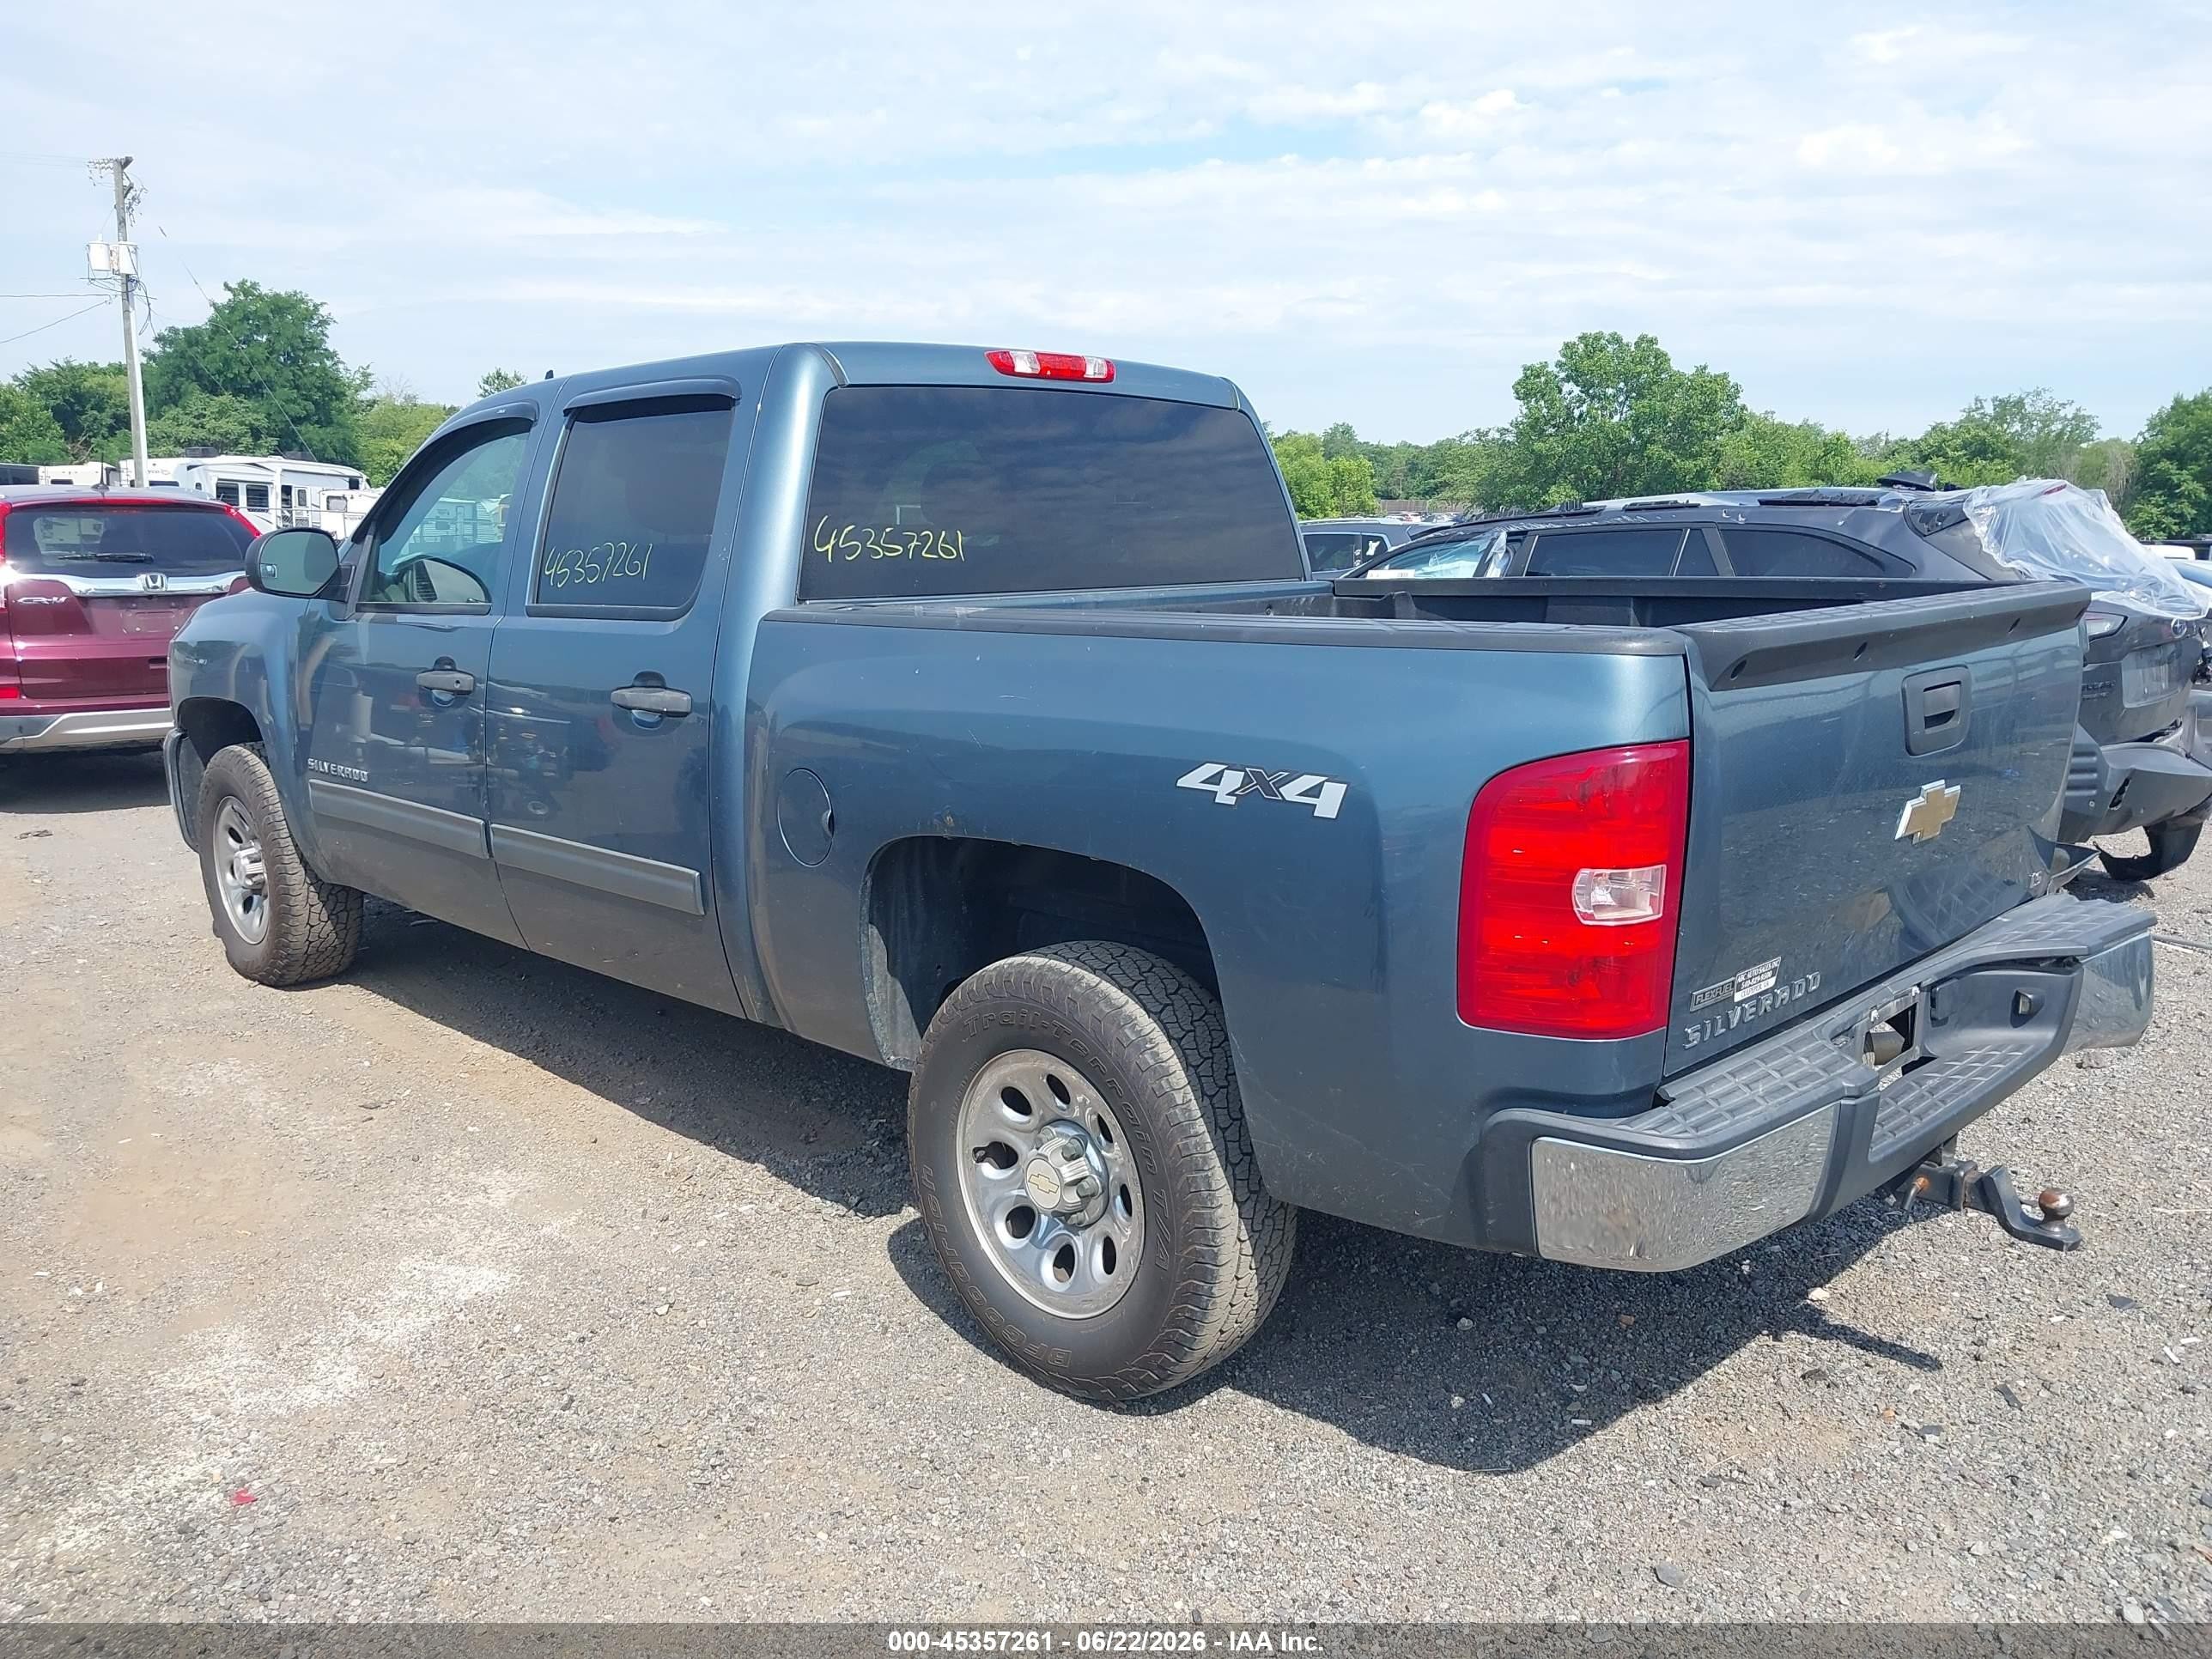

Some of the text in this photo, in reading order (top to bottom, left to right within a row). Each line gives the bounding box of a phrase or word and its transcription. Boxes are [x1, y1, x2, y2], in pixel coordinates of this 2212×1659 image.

[813, 515, 965, 562] 45357261
[544, 542, 653, 589] 45357261
[16, 596, 69, 605] CR-V
[307, 757, 369, 782] SILVERADO
[1695, 981, 1735, 1005] FLEXFUEL
[1747, 967, 1759, 979] AUTO
[1759, 962, 1771, 974] SALES
[1682, 971, 1821, 1050] SILVERADO
[963, 1008, 1172, 1271] Trail-Terrain T/A
[922, 1165, 1073, 1368] BFGoodrich
